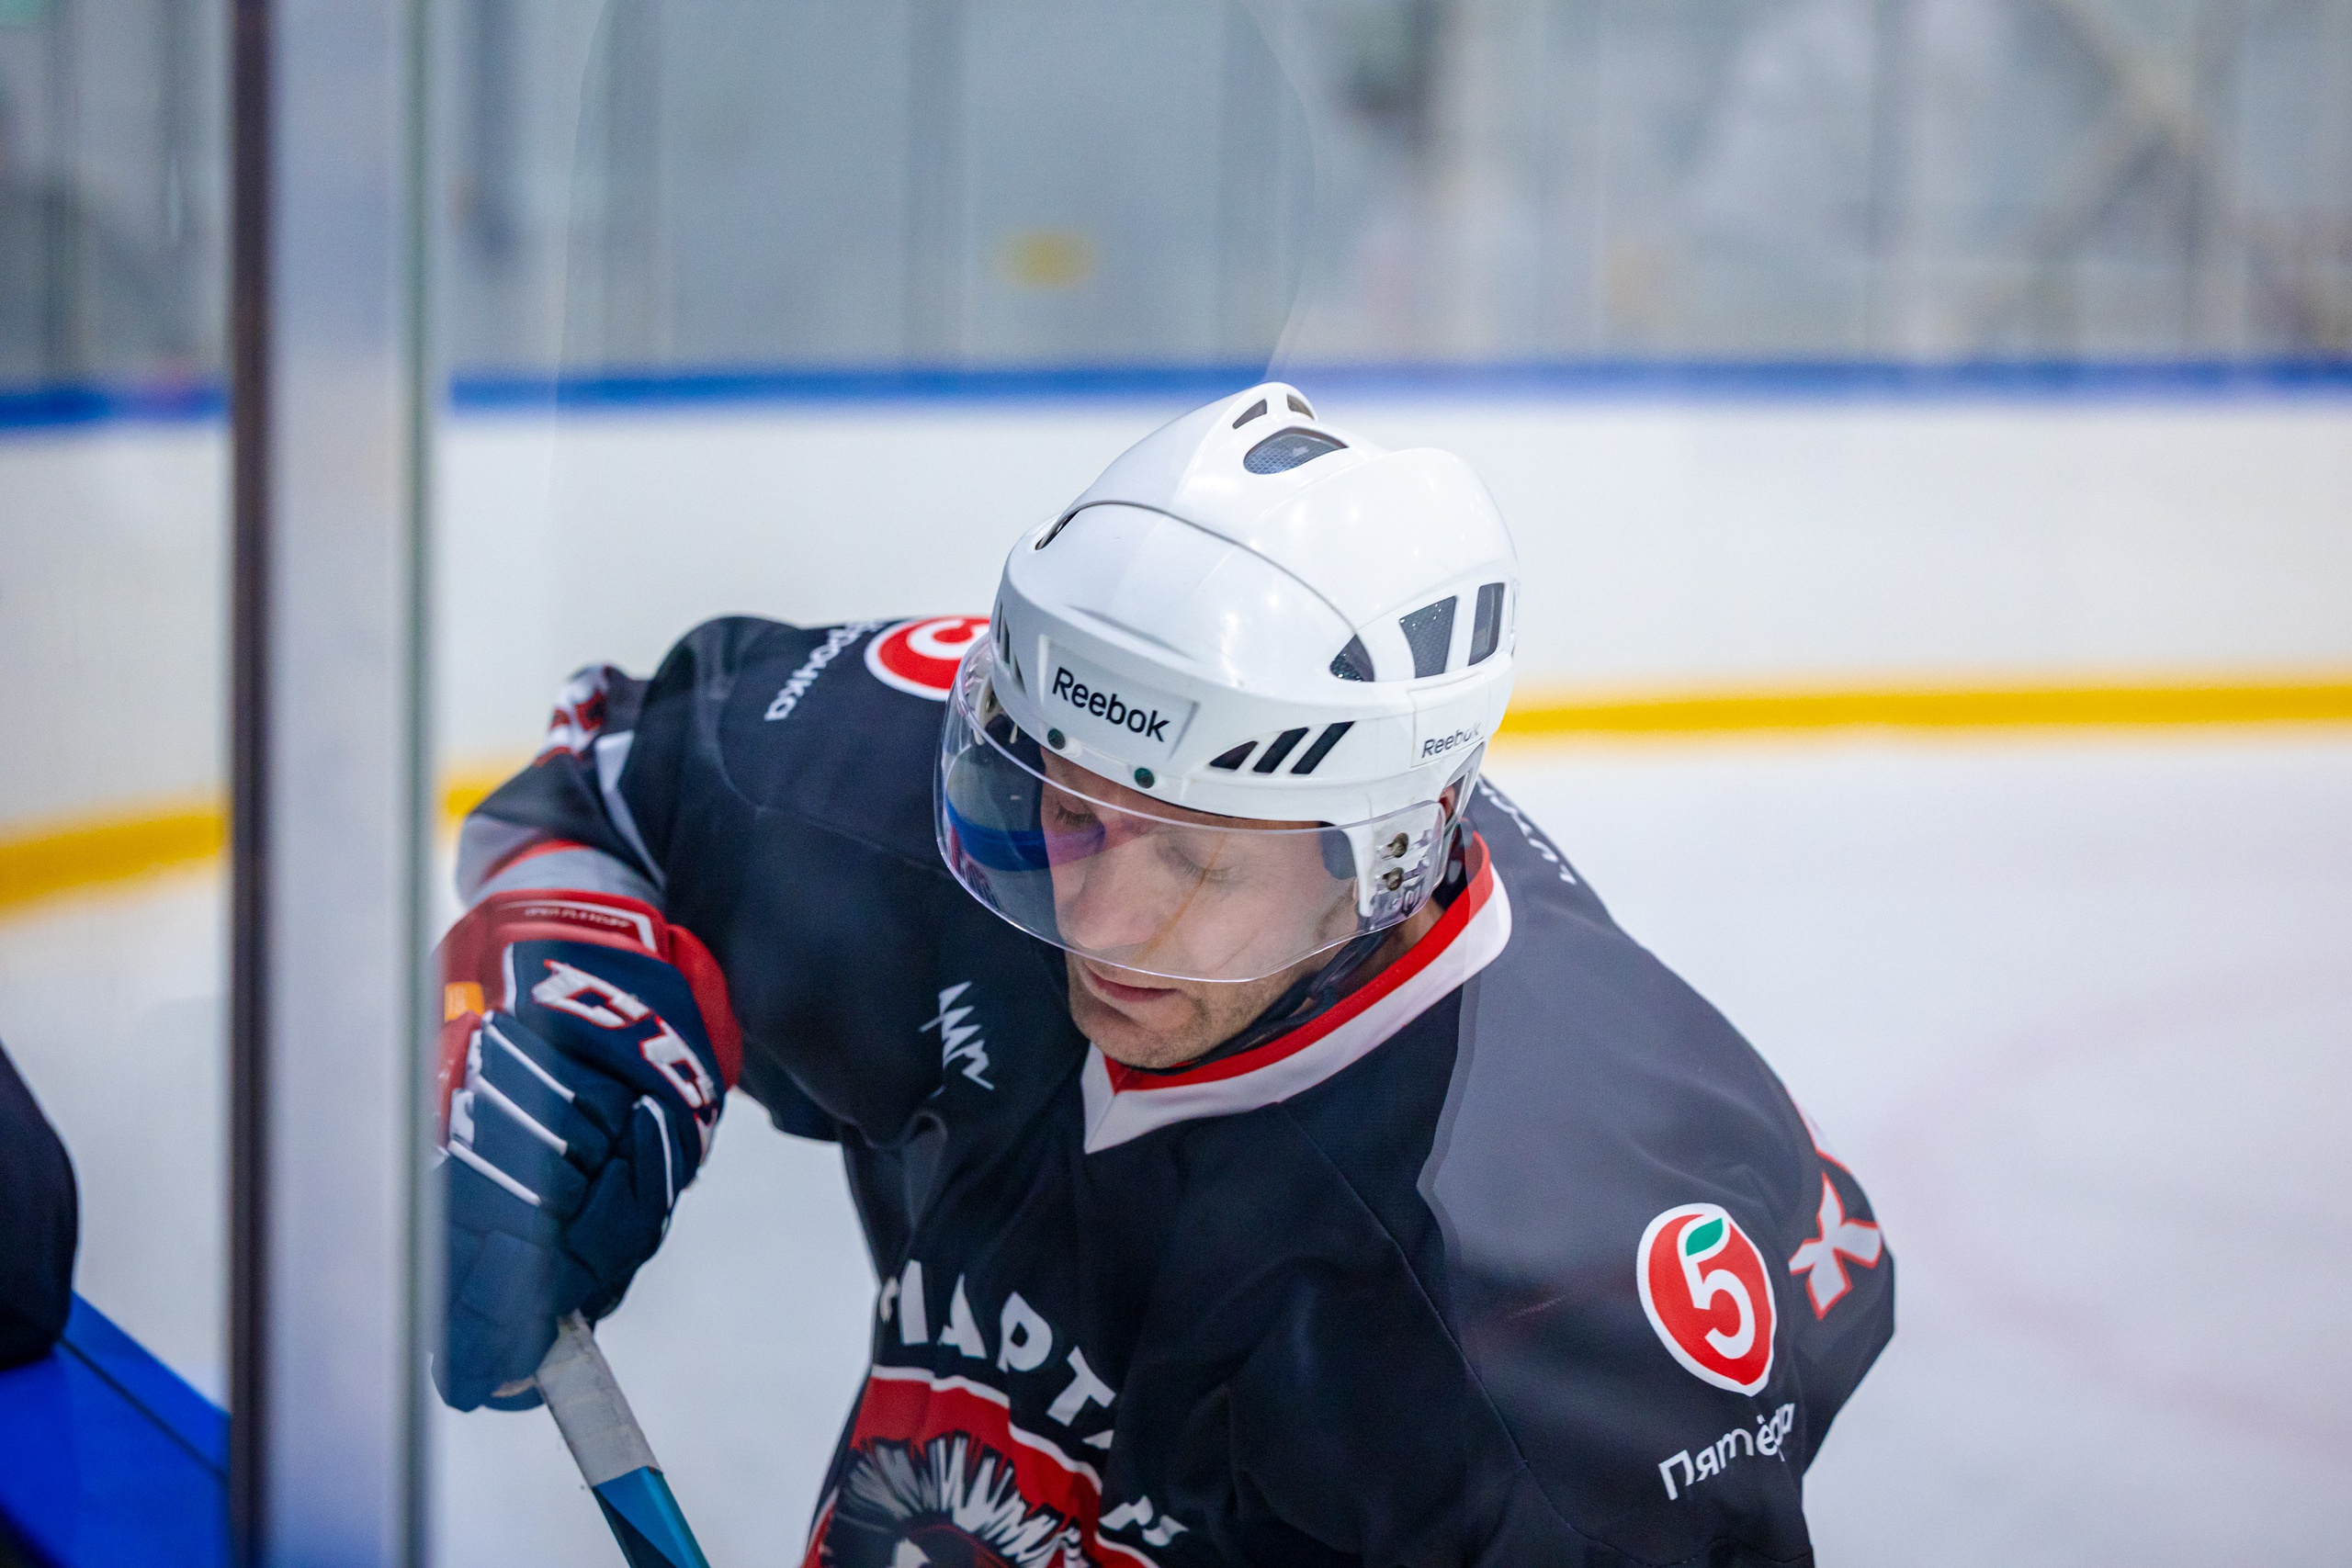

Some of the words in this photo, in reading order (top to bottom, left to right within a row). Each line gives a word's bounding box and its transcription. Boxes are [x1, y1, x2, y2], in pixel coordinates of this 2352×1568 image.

[1052, 667, 1170, 742] Reebok
[532, 959, 718, 1164] CC
[1678, 1215, 1757, 1359] 5
